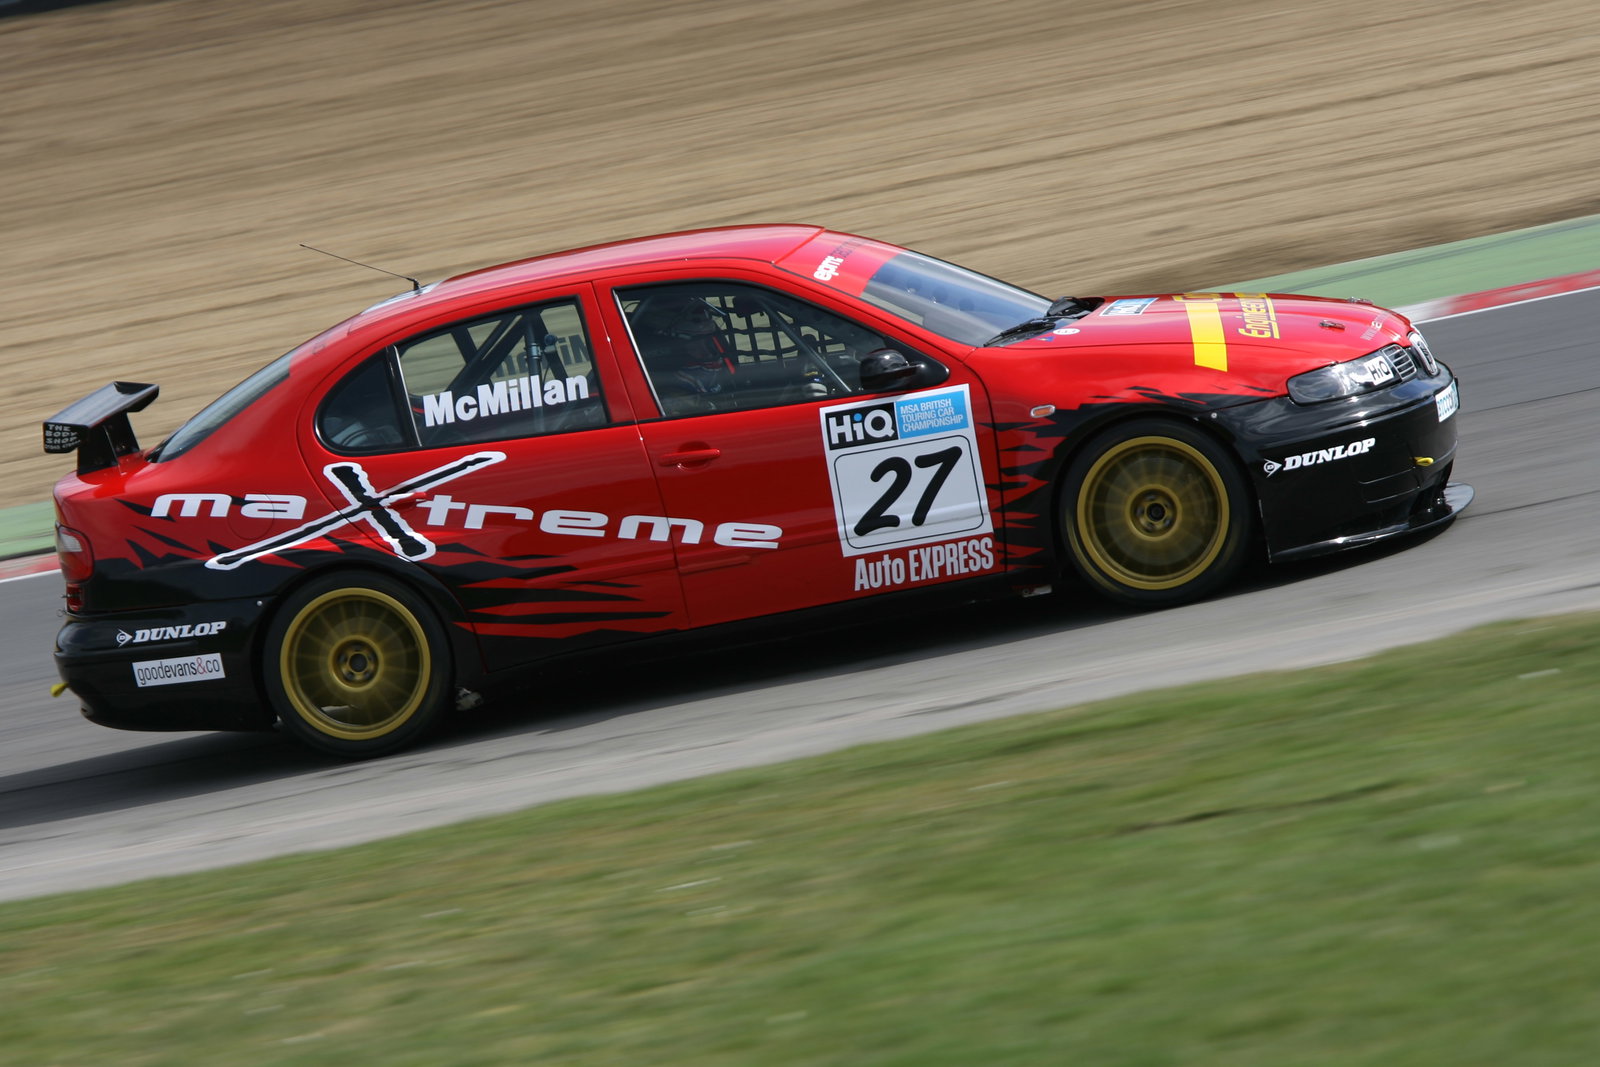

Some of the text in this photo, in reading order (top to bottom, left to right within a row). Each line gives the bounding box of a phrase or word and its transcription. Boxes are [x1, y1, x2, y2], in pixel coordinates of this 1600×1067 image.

[1367, 360, 1391, 381] HiQ
[422, 374, 590, 428] McMillan
[900, 398, 952, 415] MSA BRITISH
[902, 406, 955, 423] TOURING CAR
[828, 409, 895, 445] HiQ
[902, 414, 964, 433] CHAMPIONSHIP
[1283, 437, 1376, 471] DUNLOP
[854, 446, 963, 537] 27
[854, 537, 995, 591] Auto EXPRESS
[132, 621, 227, 643] DUNLOP
[136, 657, 221, 686] goodevans&co
